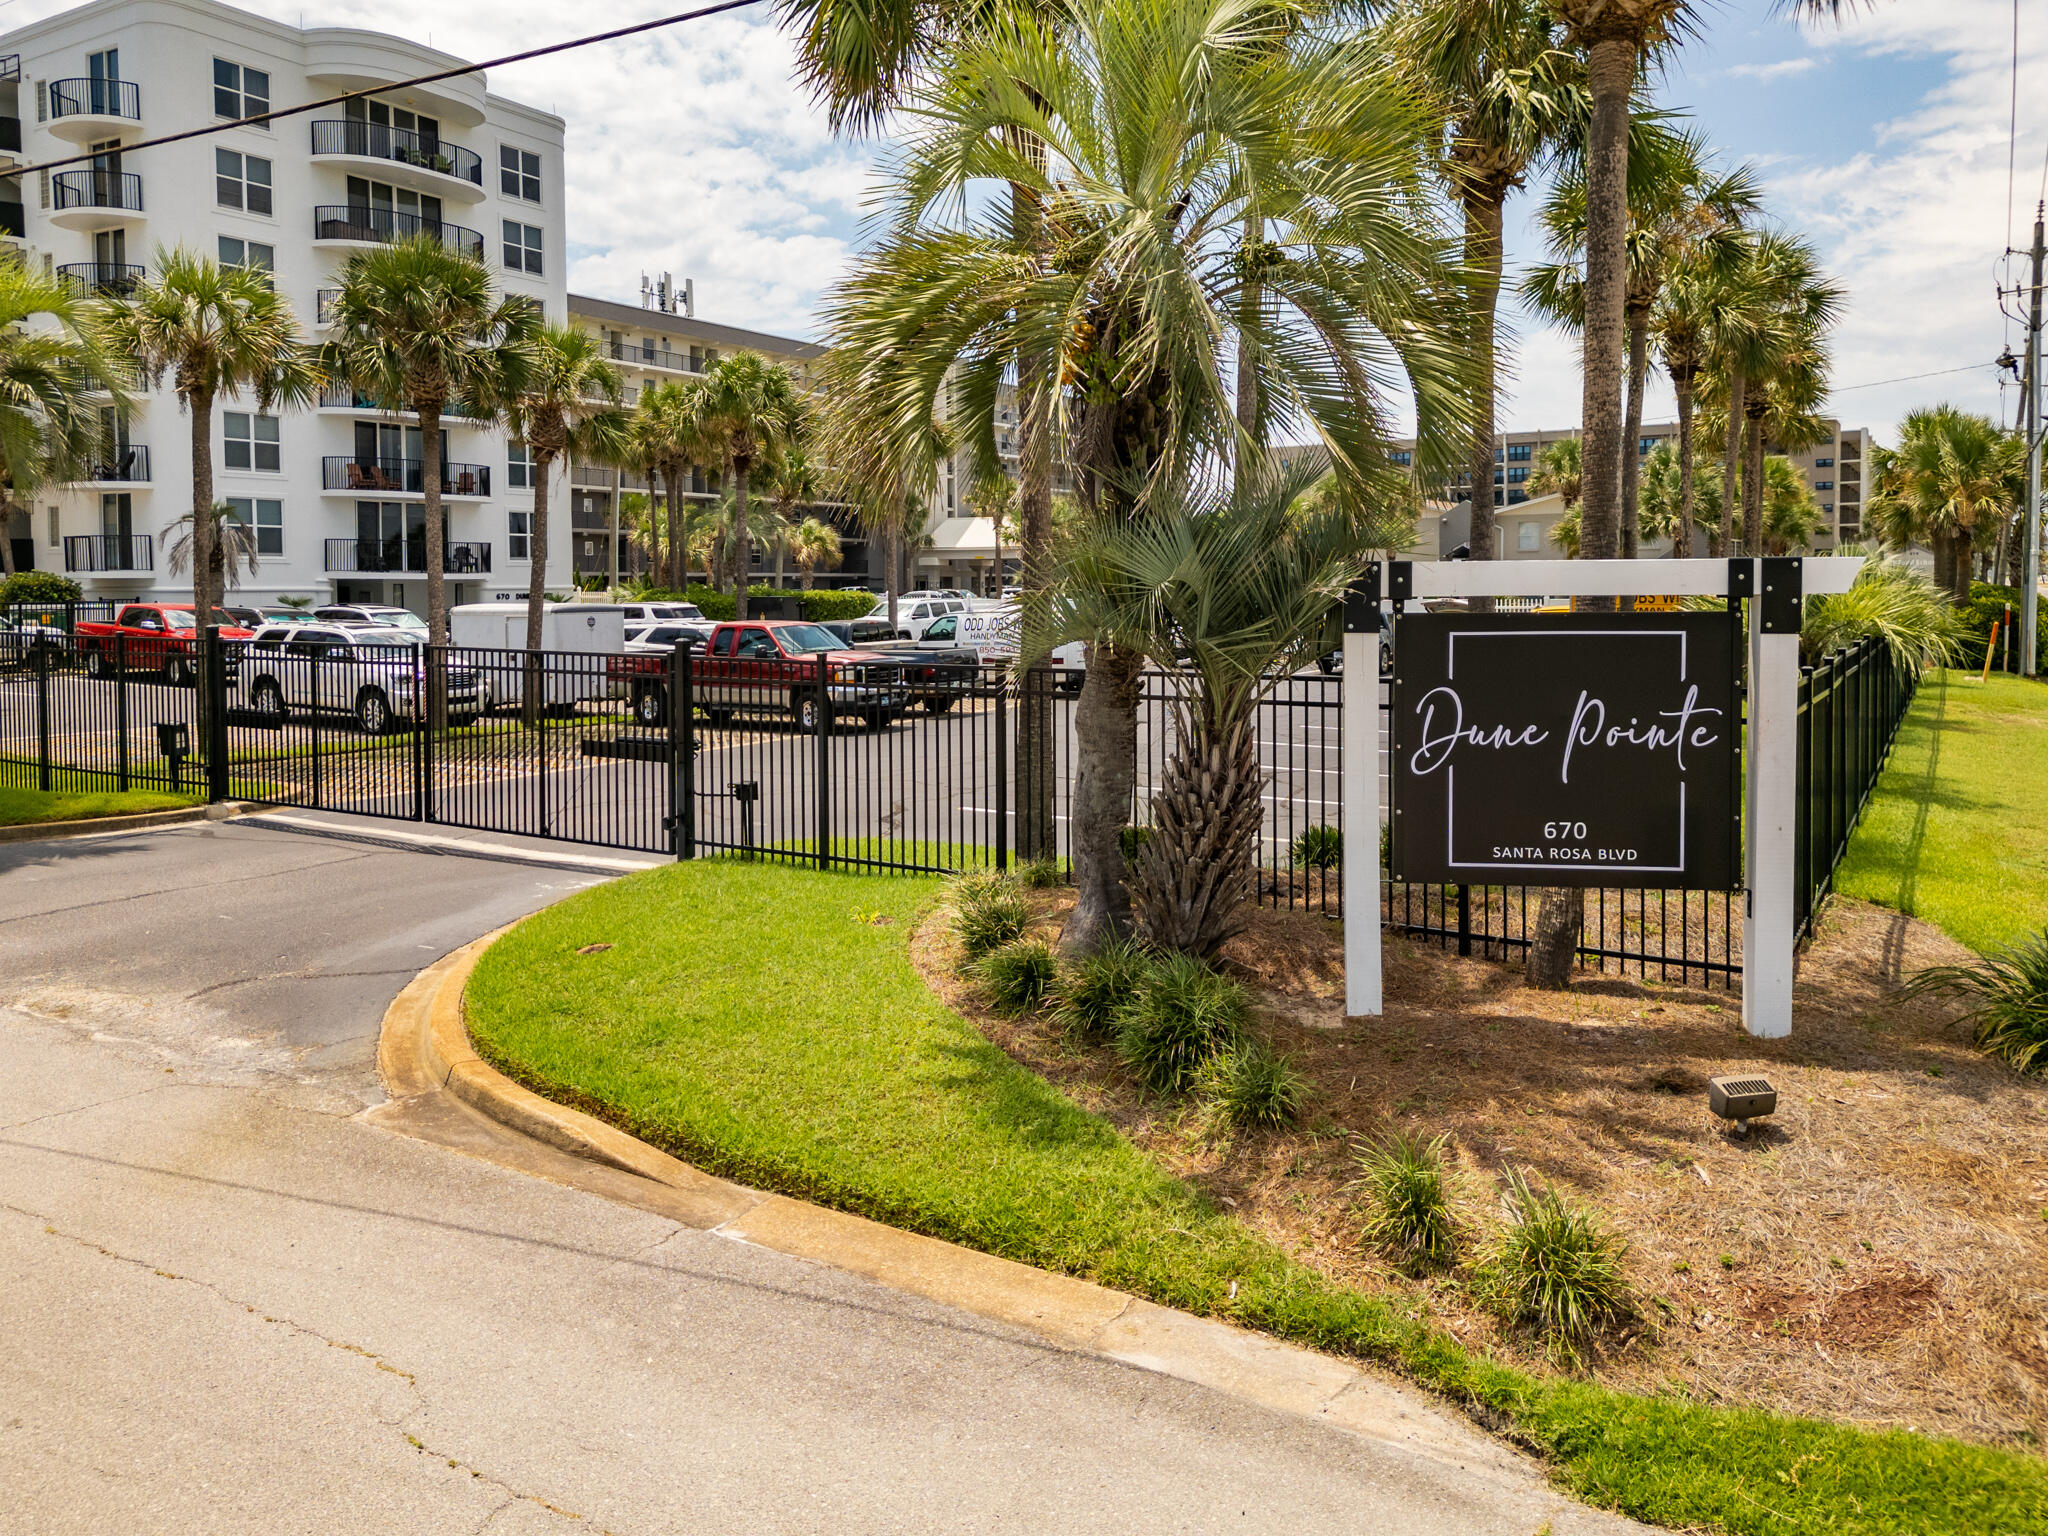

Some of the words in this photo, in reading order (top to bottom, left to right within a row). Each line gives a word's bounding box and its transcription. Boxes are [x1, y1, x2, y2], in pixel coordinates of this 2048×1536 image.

[964, 617, 984, 631] ODD
[986, 617, 1010, 631] JOBS
[1411, 687, 1549, 775] Dune
[1562, 684, 1723, 784] Pointe
[1544, 822, 1587, 839] 670
[1492, 846, 1544, 860] SANTA
[1549, 847, 1592, 860] ROSA
[1598, 848, 1638, 861] BLVD
